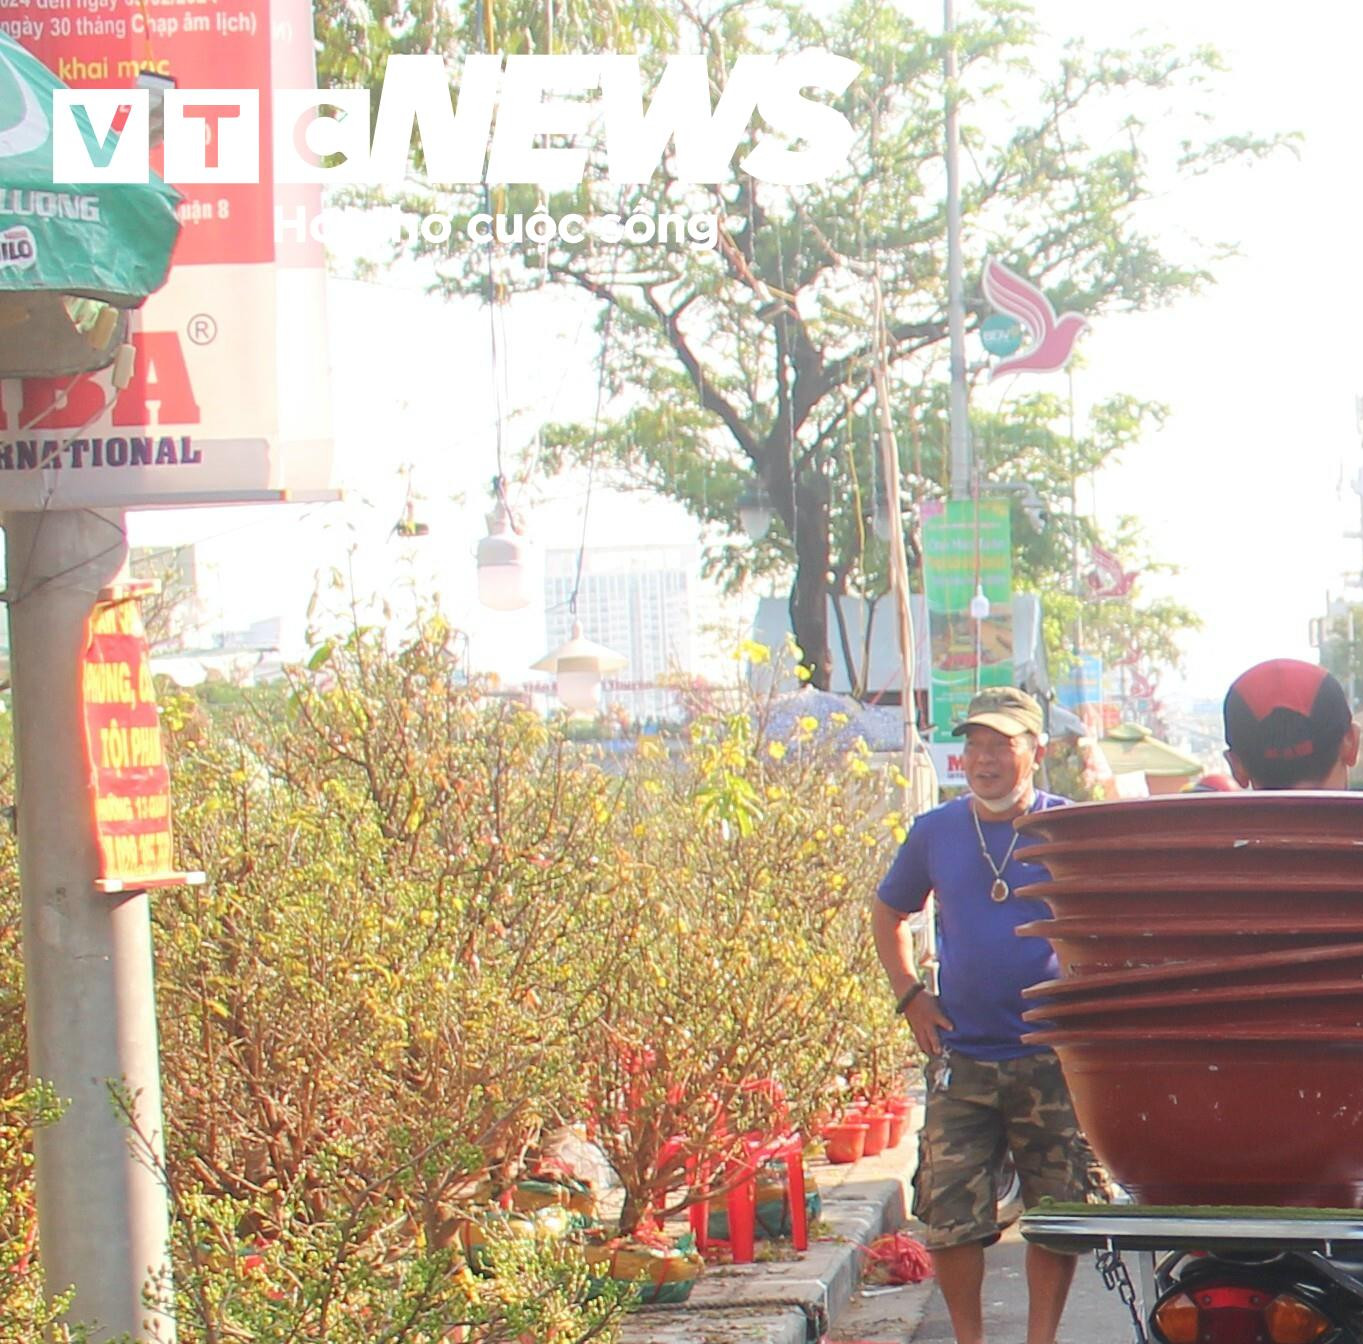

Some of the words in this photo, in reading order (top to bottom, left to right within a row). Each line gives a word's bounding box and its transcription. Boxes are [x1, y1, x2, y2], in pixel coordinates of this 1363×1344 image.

[50, 18, 71, 36] 30
[183, 12, 210, 31] âm
[58, 56, 109, 80] khai
[180, 198, 212, 224] uận
[217, 199, 230, 219] 8
[0, 239, 33, 261] ILO
